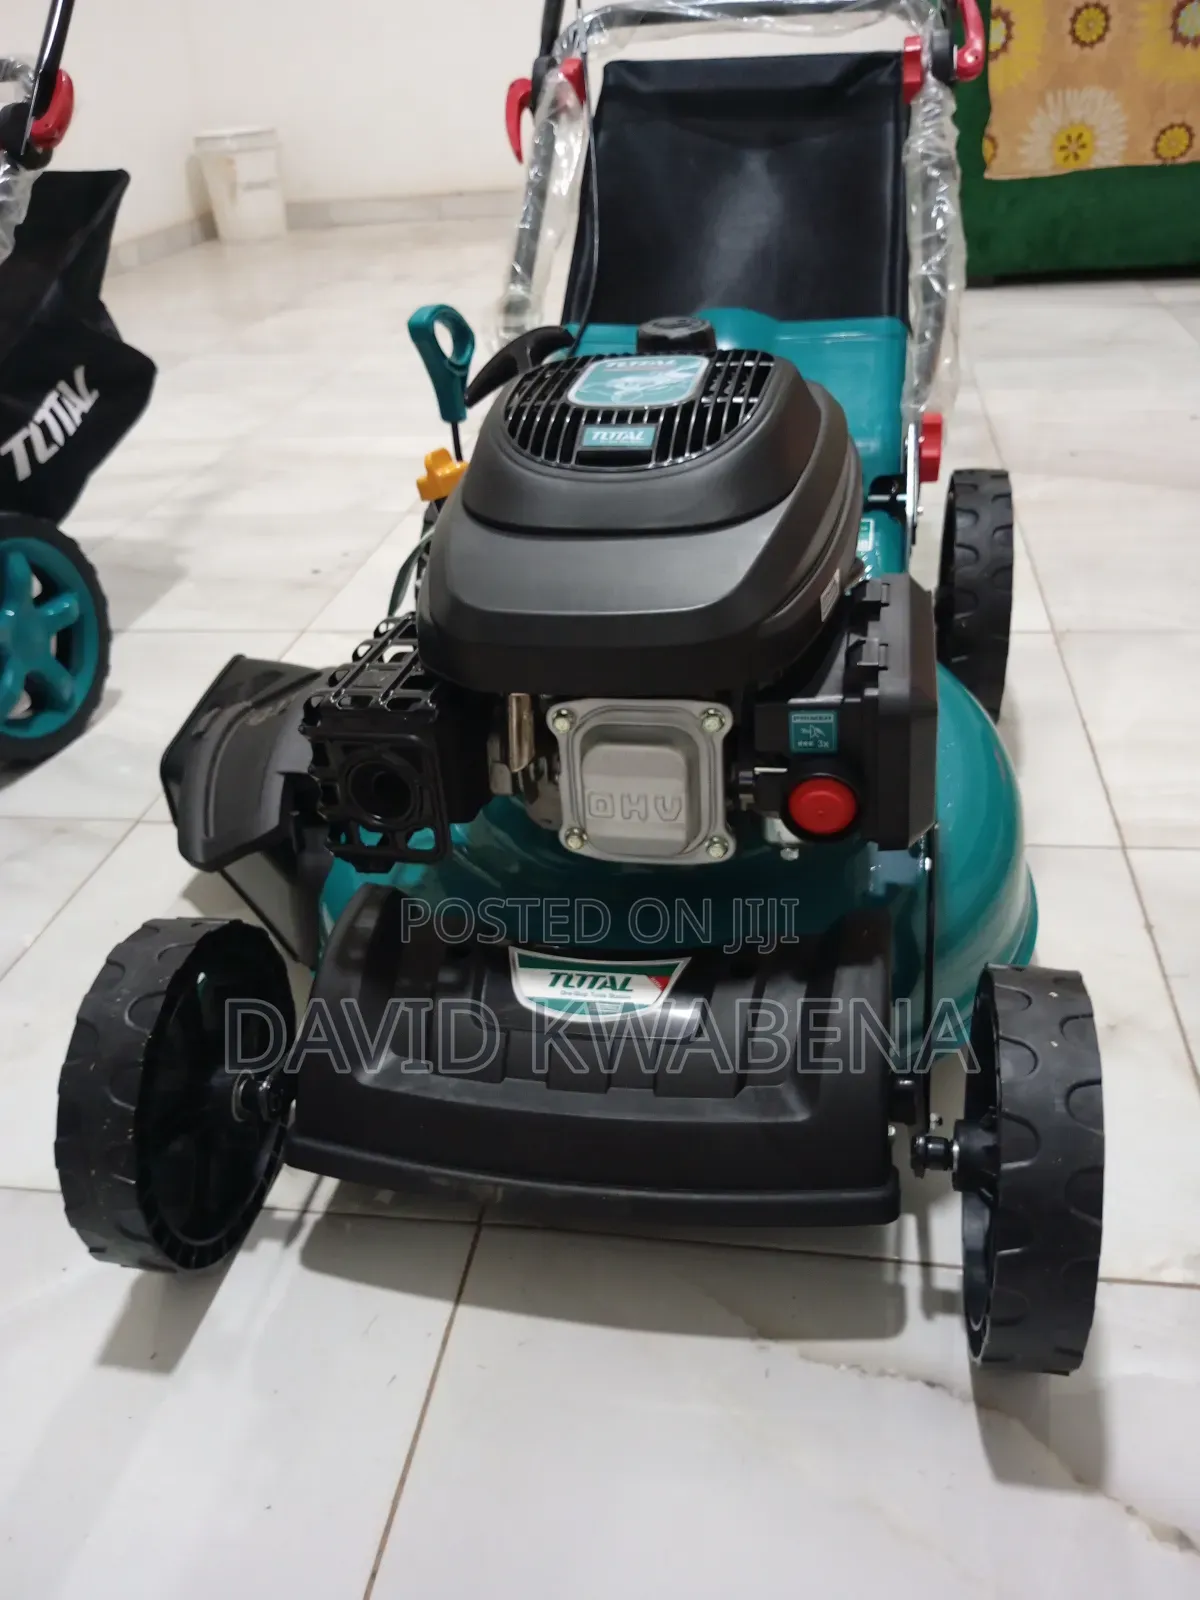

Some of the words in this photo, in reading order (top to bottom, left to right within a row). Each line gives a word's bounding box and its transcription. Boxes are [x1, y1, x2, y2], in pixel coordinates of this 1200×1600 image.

[0, 364, 100, 481] TOTAL
[592, 431, 645, 441] TOTAL
[587, 791, 683, 822] OHV
[548, 972, 634, 992] TOTAL
